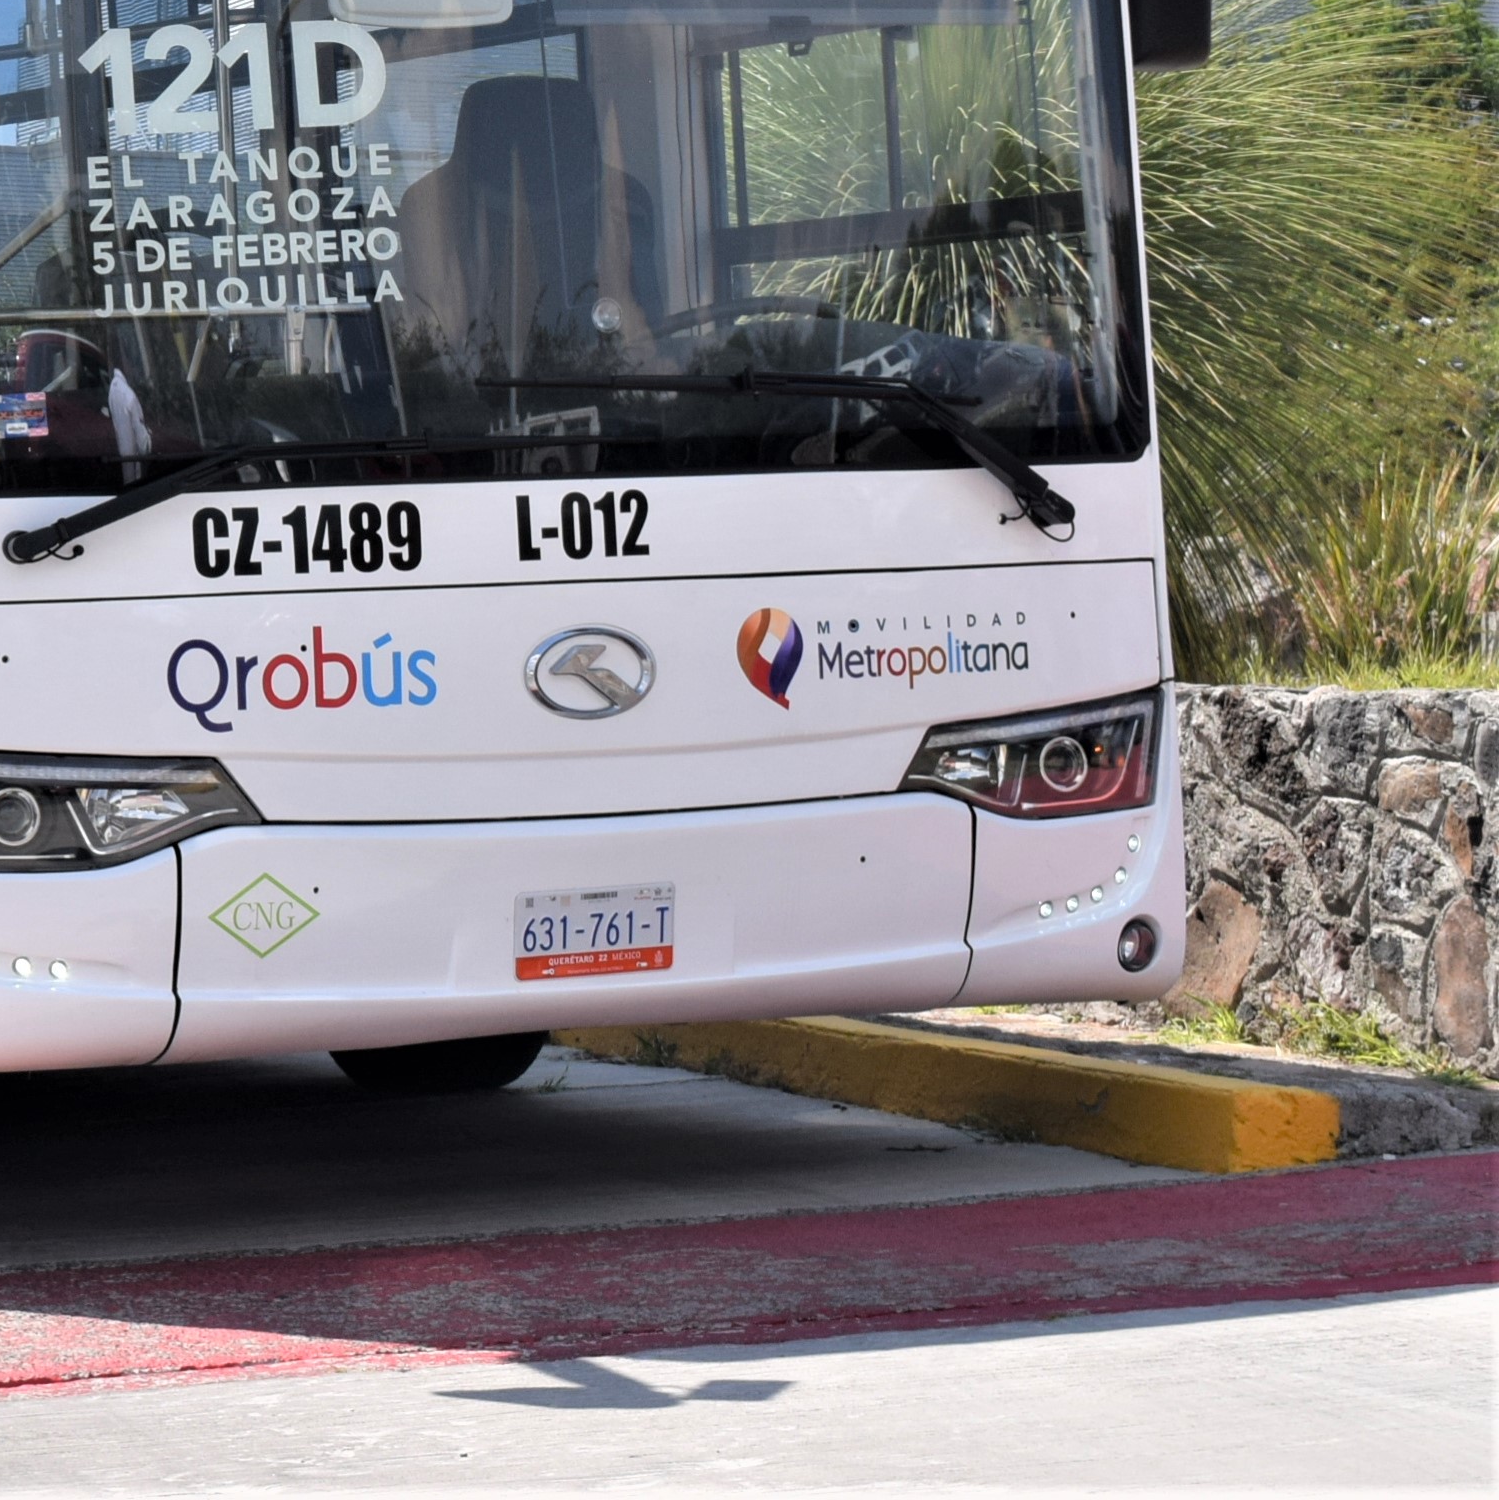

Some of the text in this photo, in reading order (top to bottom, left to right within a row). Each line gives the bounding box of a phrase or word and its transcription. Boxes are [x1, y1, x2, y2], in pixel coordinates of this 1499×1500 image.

[77, 20, 386, 137] 121D
[87, 143, 392, 190] EL TANQUE
[88, 186, 397, 232] ZARAGOZA
[93, 227, 398, 275] 5 DE FEBRERO
[94, 269, 404, 318] JURIQUILLA
[191, 488, 650, 579] CZ-1489 L-012
[816, 612, 1026, 634] MOVILIDAD
[167, 625, 437, 732] Qrobús
[818, 631, 1029, 689] Metropolitana
[233, 901, 295, 931] CNG
[523, 906, 669, 952] 631-761-T
[548, 950, 641, 966] QUERÉTARO 22 MÉXICO
